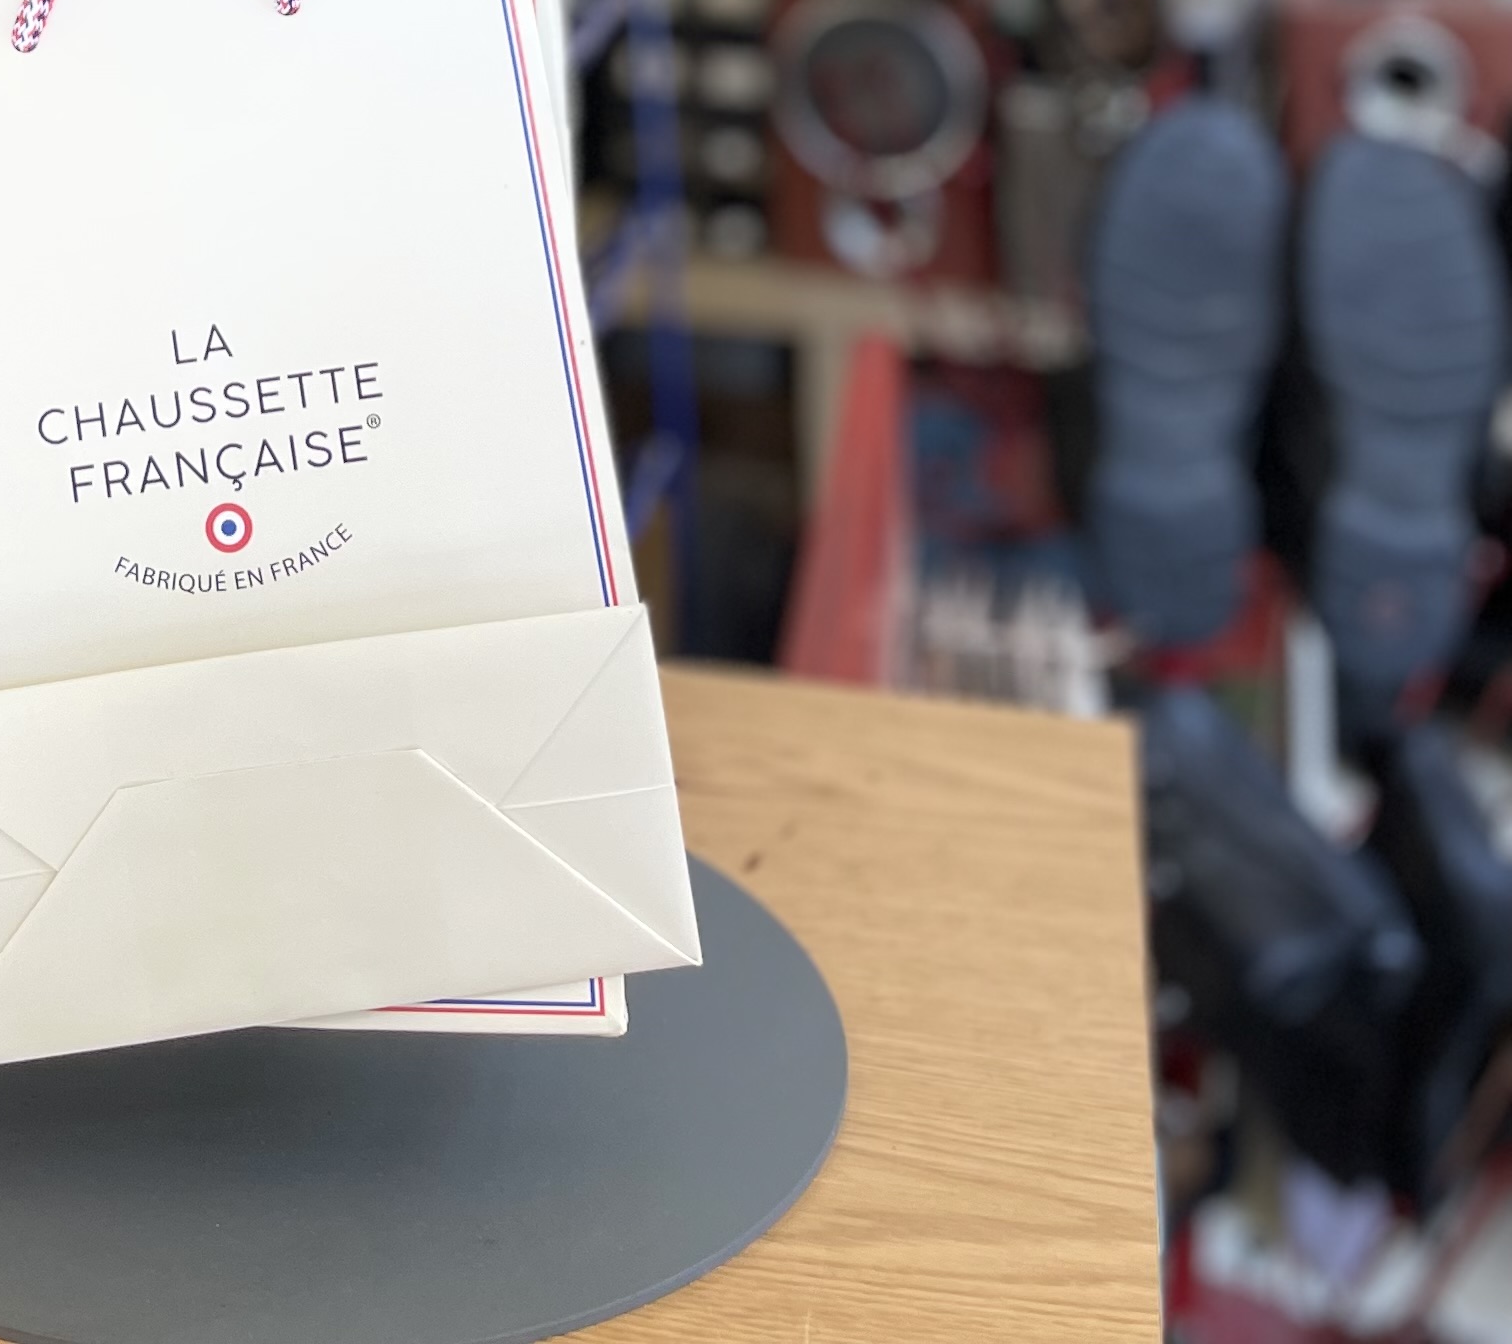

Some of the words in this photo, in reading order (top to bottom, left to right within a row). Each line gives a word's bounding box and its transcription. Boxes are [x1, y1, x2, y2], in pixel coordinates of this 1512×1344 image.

[171, 323, 234, 366] LA
[37, 361, 384, 445] CHAUSSETTE
[114, 555, 228, 595] FABRIQUÉ
[234, 566, 265, 591] EN
[269, 522, 353, 582] FRANCE
